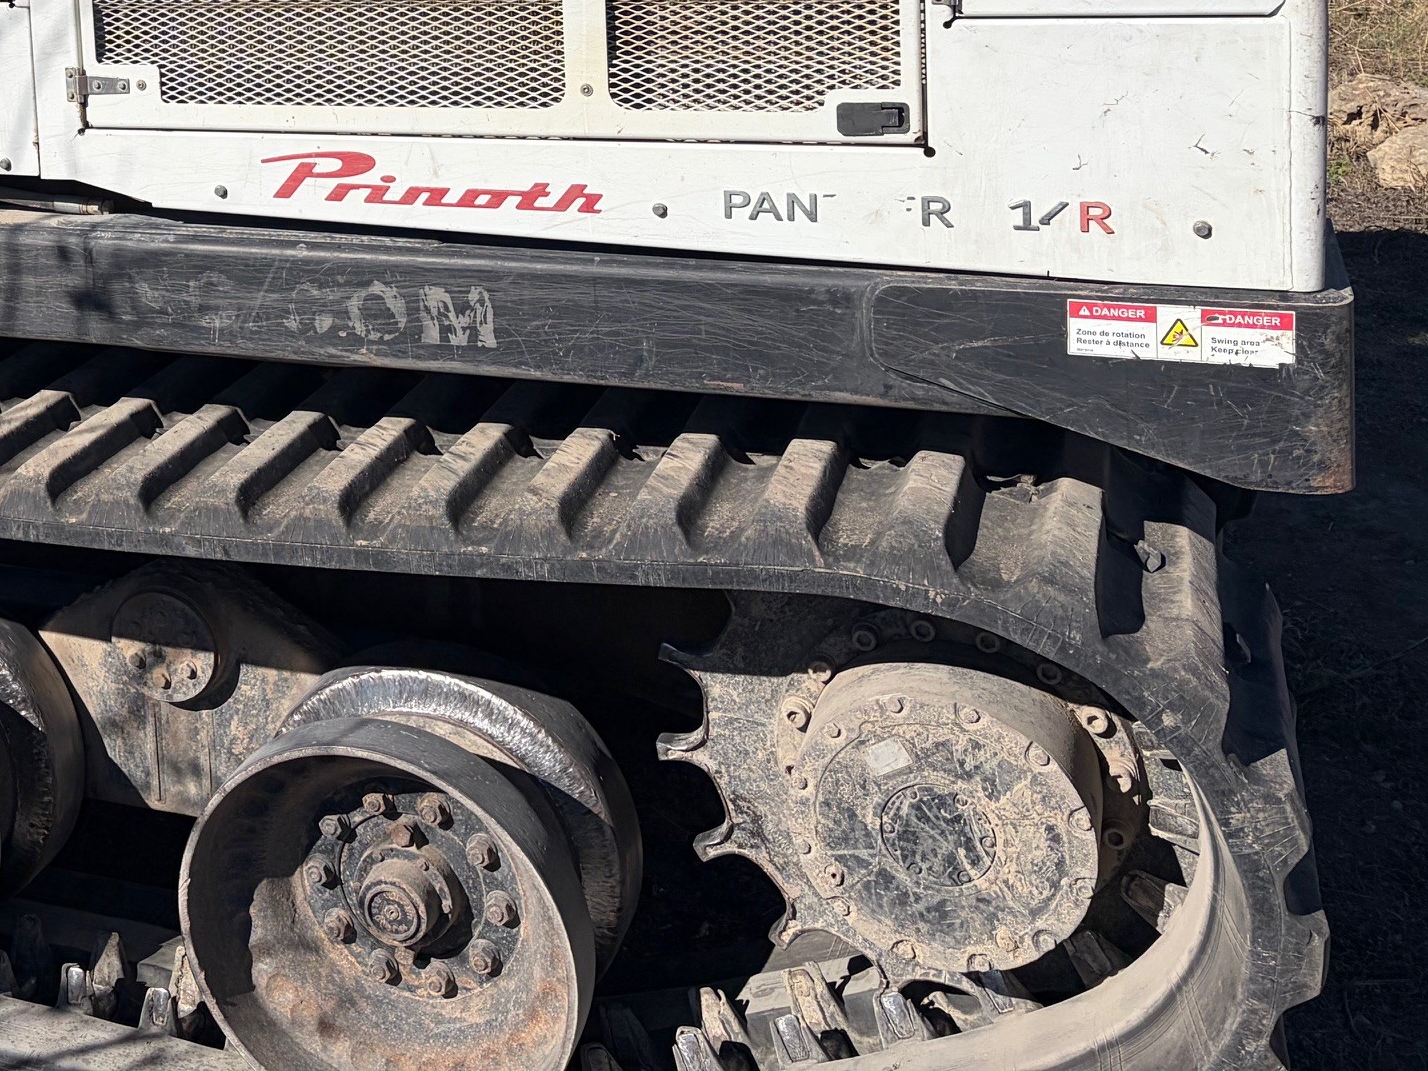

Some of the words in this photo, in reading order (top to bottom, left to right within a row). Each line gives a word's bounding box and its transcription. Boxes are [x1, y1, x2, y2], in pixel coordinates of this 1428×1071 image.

[260, 150, 604, 214] Prinoth
[1092, 306, 1146, 319] DANGER
[1225, 314, 1281, 327] DANGER
[1076, 328, 1097, 336] Zone
[1099, 329, 1110, 337] de
[1112, 331, 1146, 340] rotation
[1076, 337, 1104, 346] Rester
[1105, 338, 1111, 346] à
[1112, 339, 1150, 349] distance
[1211, 337, 1239, 347] Swing
[1211, 345, 1234, 355] Keep
